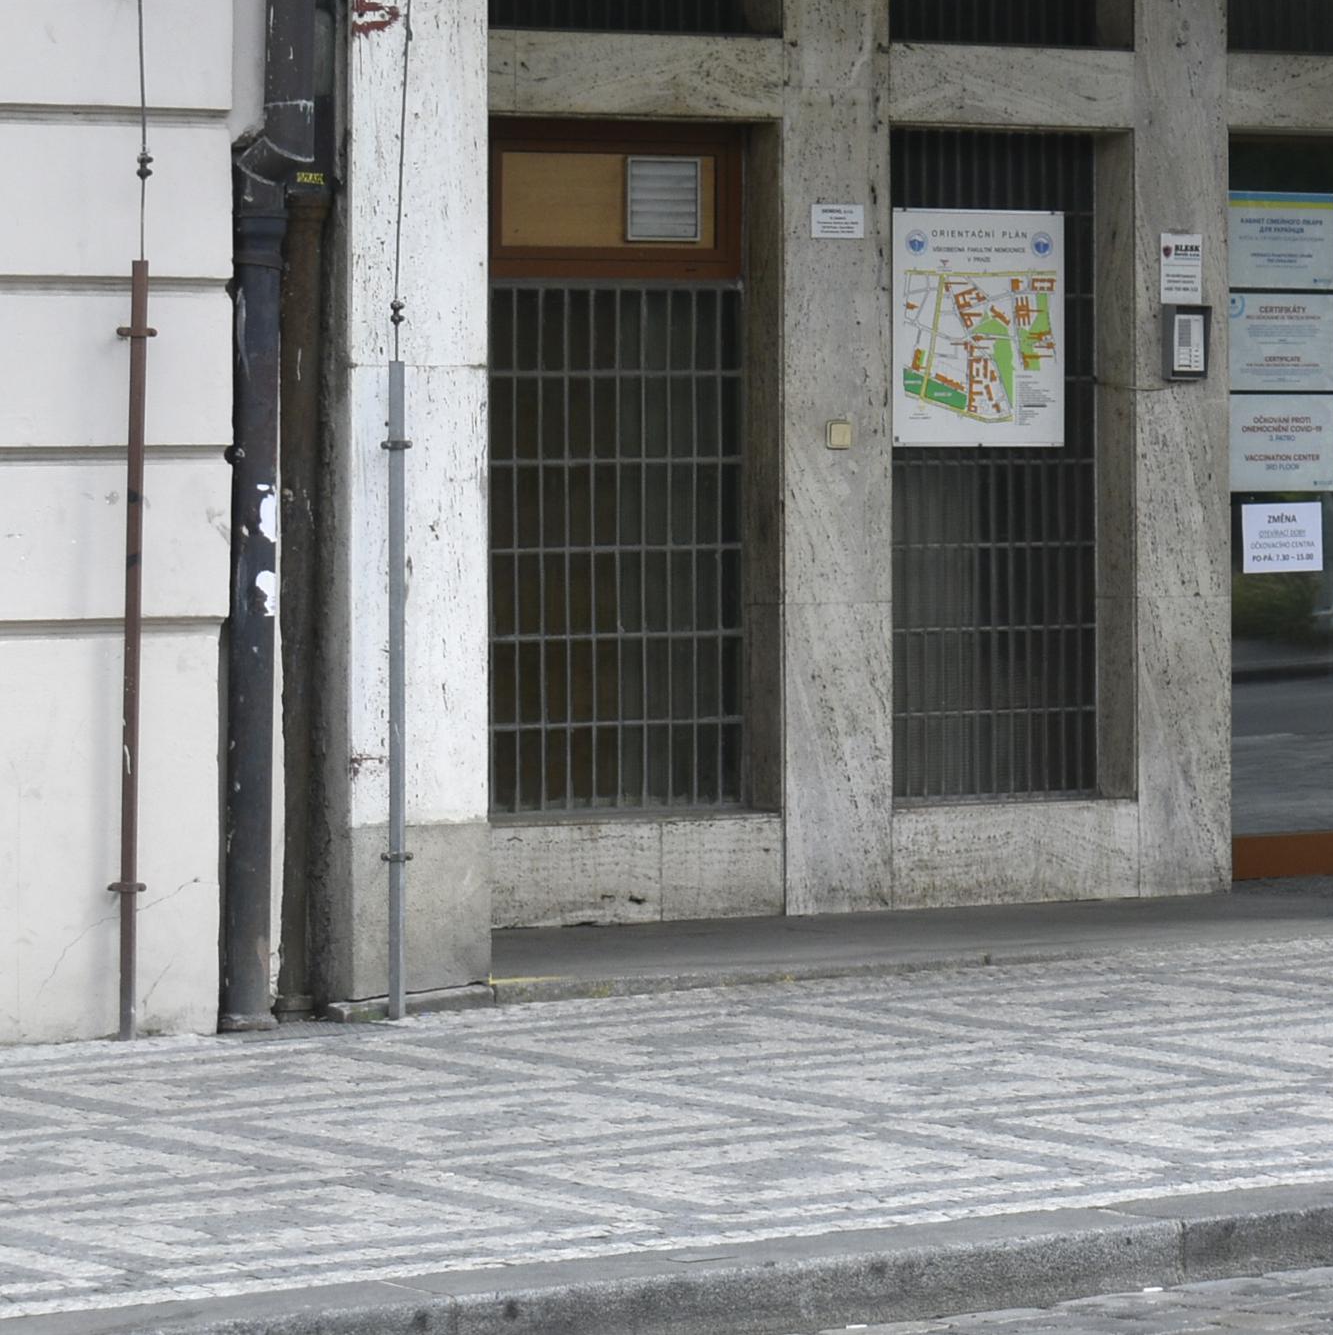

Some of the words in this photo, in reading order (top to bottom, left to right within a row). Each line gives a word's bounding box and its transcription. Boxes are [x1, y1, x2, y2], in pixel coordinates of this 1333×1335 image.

[931, 229, 995, 239] ORIENTAČNÍ
[1259, 304, 1306, 314] CERTIFIKÁTY
[1291, 416, 1311, 424] PROTI
[1290, 425, 1322, 433] COVID-19
[1244, 454, 1292, 462] VACCINATION
[1267, 512, 1297, 524] ZMĚNA
[1250, 541, 1290, 550] OČKOVACÍHO
[1291, 540, 1316, 548] CENTRA
[1276, 553, 1290, 562] 7.30
